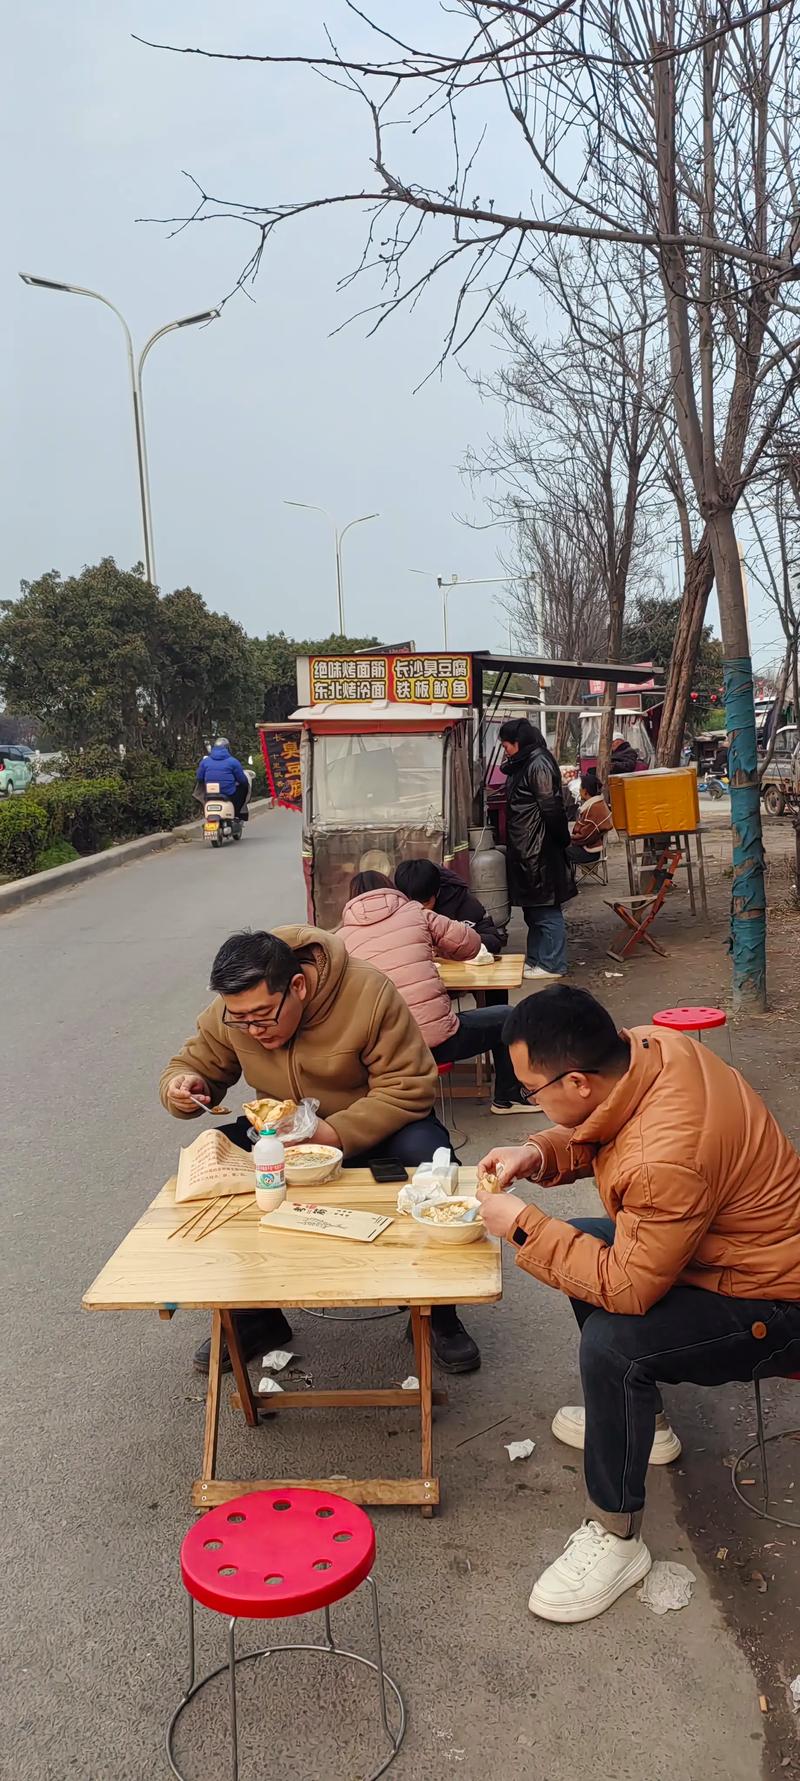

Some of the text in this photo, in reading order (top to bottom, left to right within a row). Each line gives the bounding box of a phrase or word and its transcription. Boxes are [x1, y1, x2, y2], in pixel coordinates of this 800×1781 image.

[314, 660, 386, 679] 绝味烤面筋
[394, 659, 468, 678] 长沙臭豆腐
[314, 681, 386, 699] 东北烤冷面
[396, 680, 467, 699] 铁板鱿鱼
